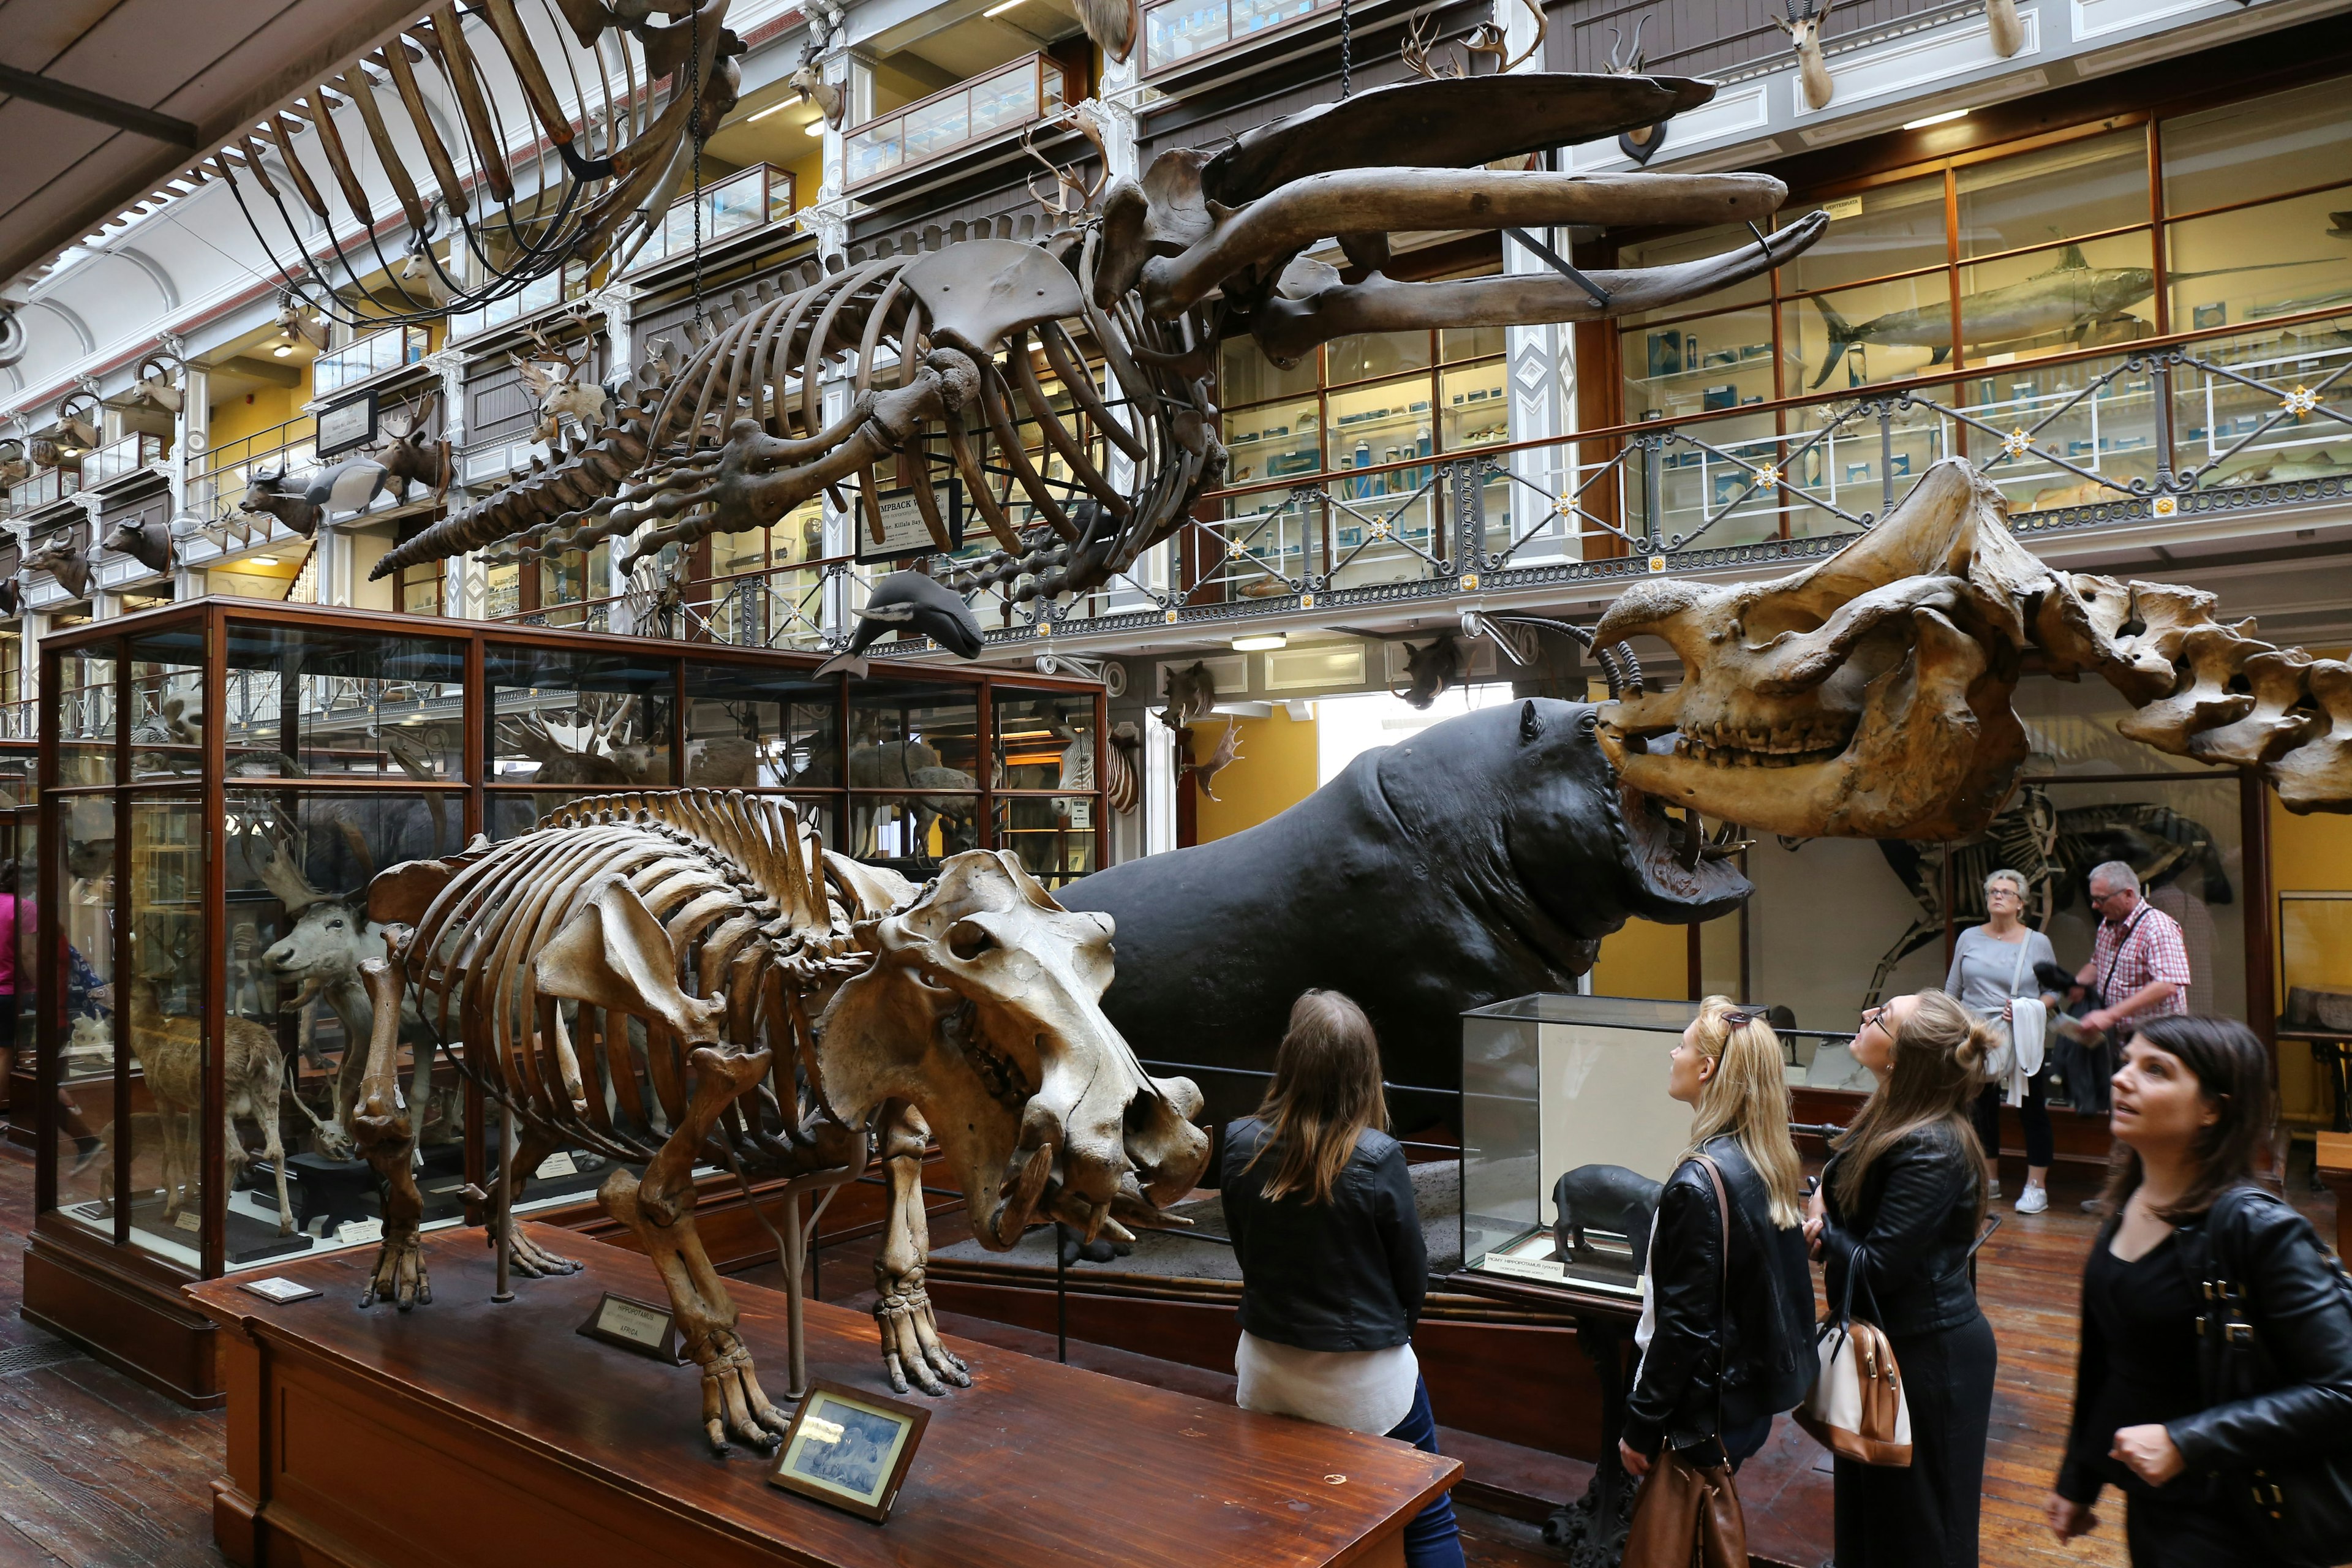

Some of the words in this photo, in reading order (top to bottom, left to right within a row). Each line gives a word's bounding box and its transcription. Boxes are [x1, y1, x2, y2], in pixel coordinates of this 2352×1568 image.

[1826, 199, 1858, 210] VERTEBRATA
[879, 500, 911, 513] MPBACK
[1504, 1259, 1541, 1268] HIPPOPOTAMUS
[620, 1325, 638, 1336] AFRICA
